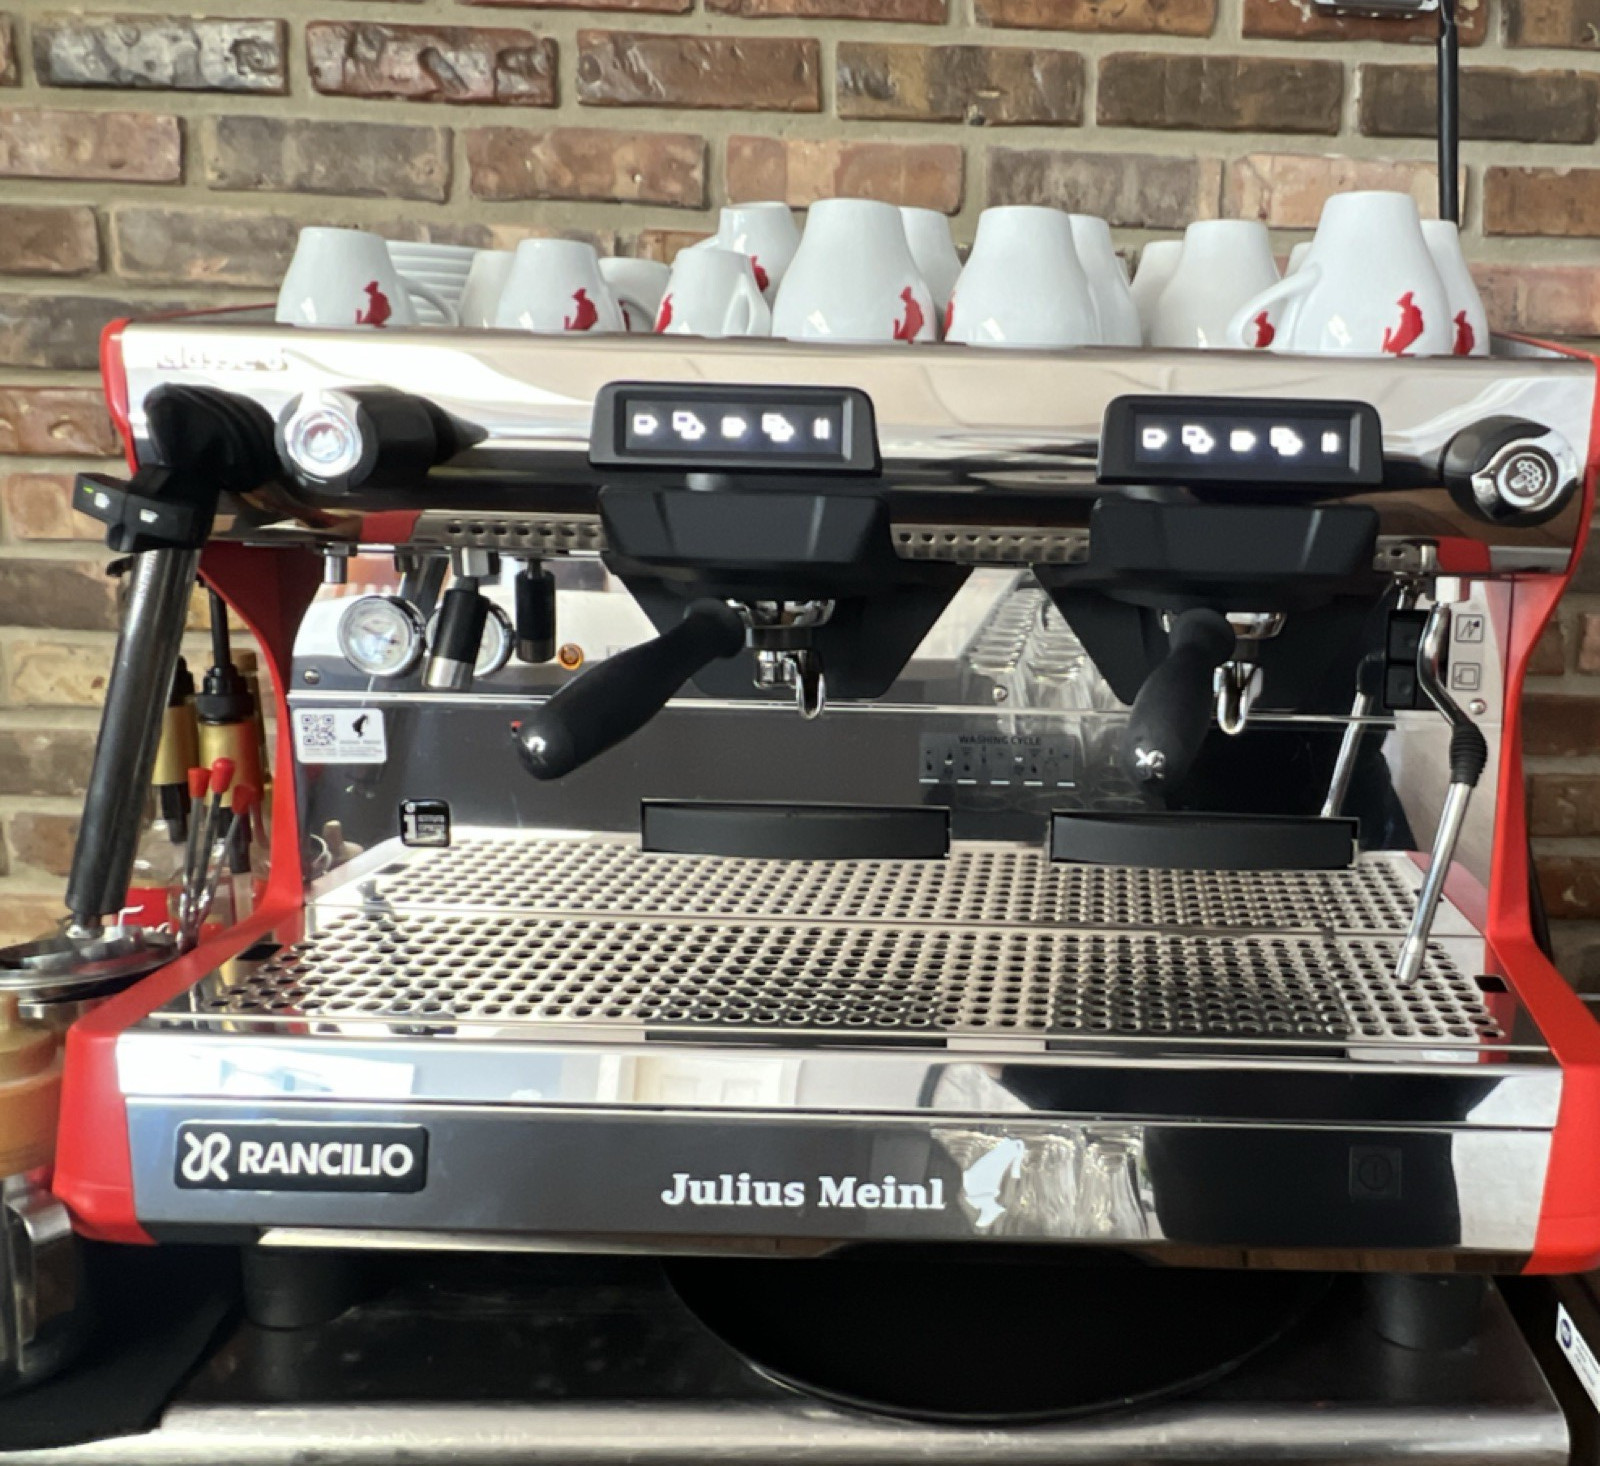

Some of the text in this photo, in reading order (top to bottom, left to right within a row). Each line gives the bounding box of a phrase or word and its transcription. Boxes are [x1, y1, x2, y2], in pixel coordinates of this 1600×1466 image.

[959, 735, 1042, 746] WASHING CYCLE
[238, 1141, 414, 1176] RANCILIO
[661, 1173, 946, 1210] Julius Meinl
